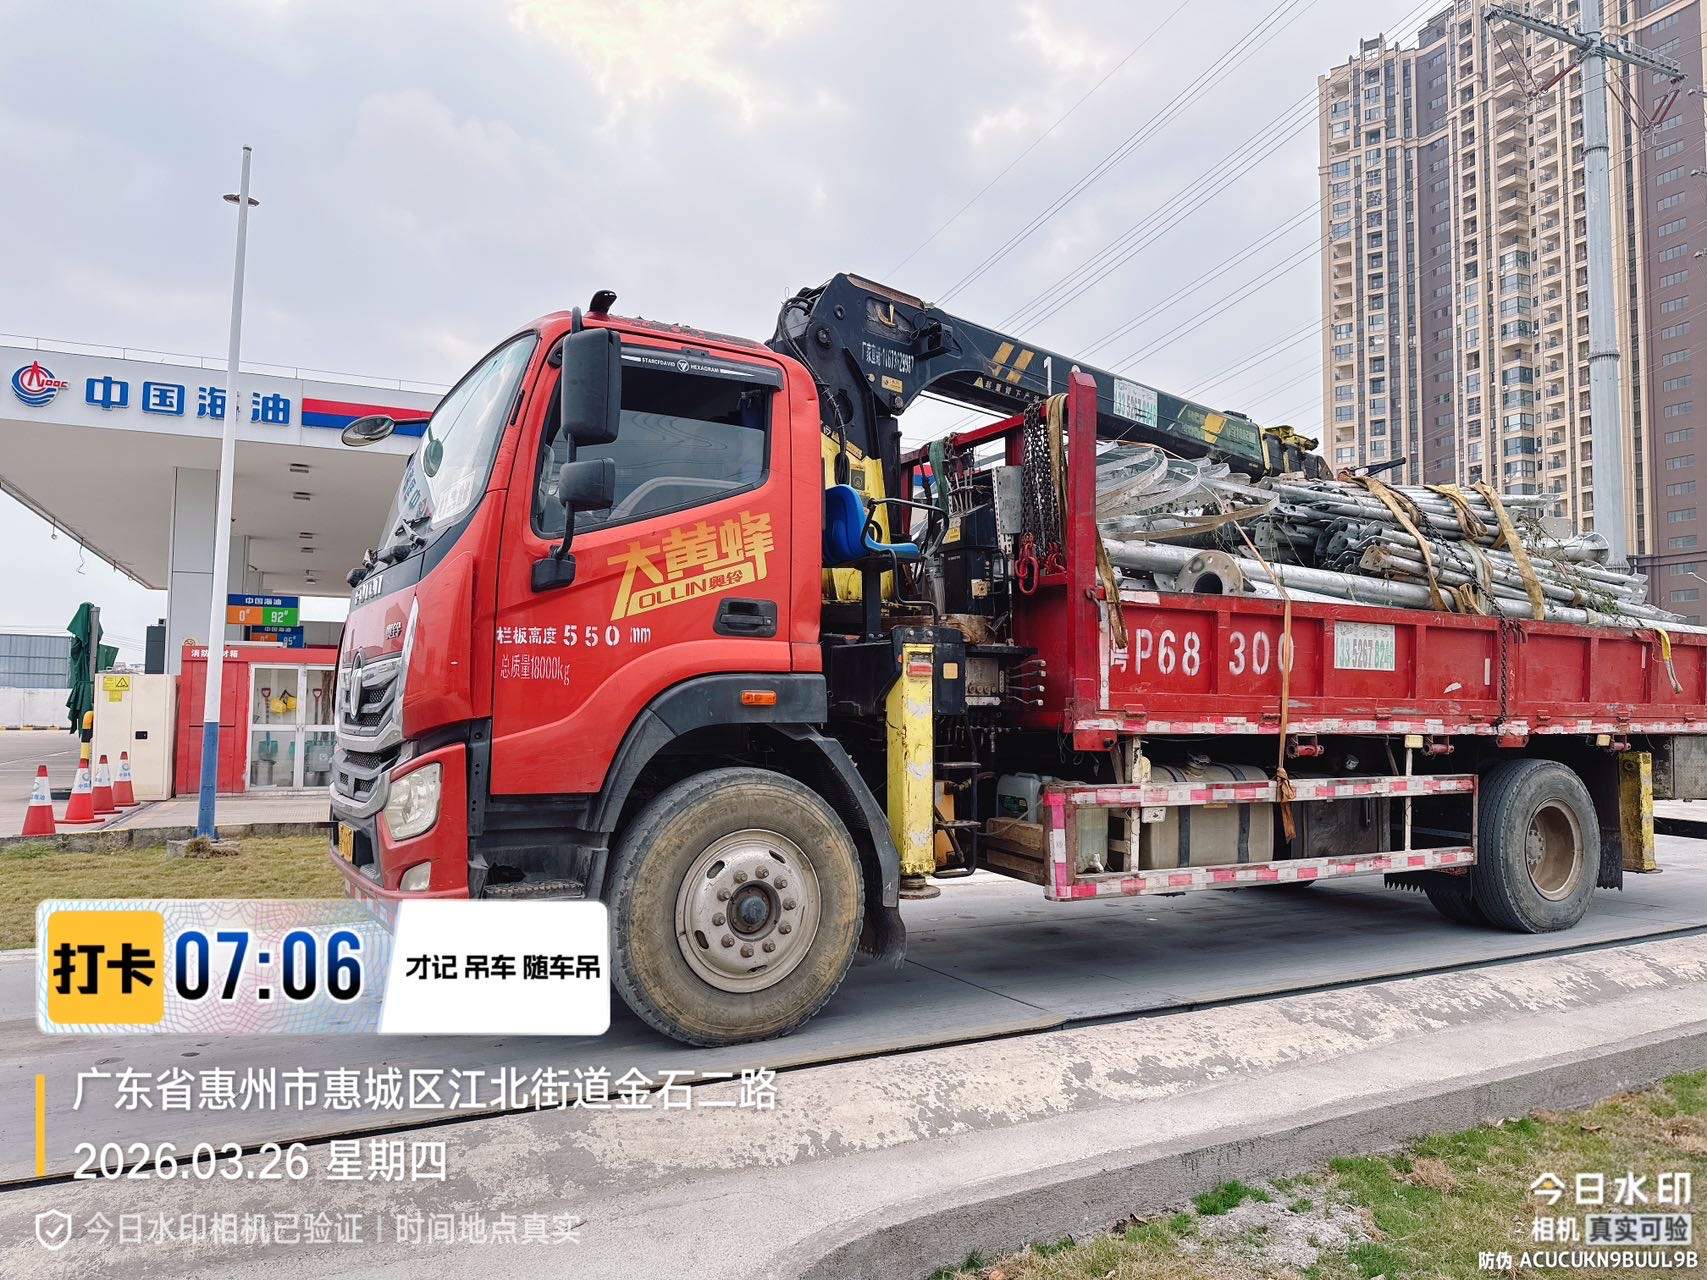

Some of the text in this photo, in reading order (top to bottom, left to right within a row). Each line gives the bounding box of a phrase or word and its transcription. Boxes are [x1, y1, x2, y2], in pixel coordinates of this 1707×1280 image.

[85, 375, 290, 425] 中国海油
[606, 510, 775, 621] 大黄蜂
[638, 578, 707, 609] OLLIN
[496, 626, 557, 645] 栏板高度
[191, 648, 239, 659] 消防材箱
